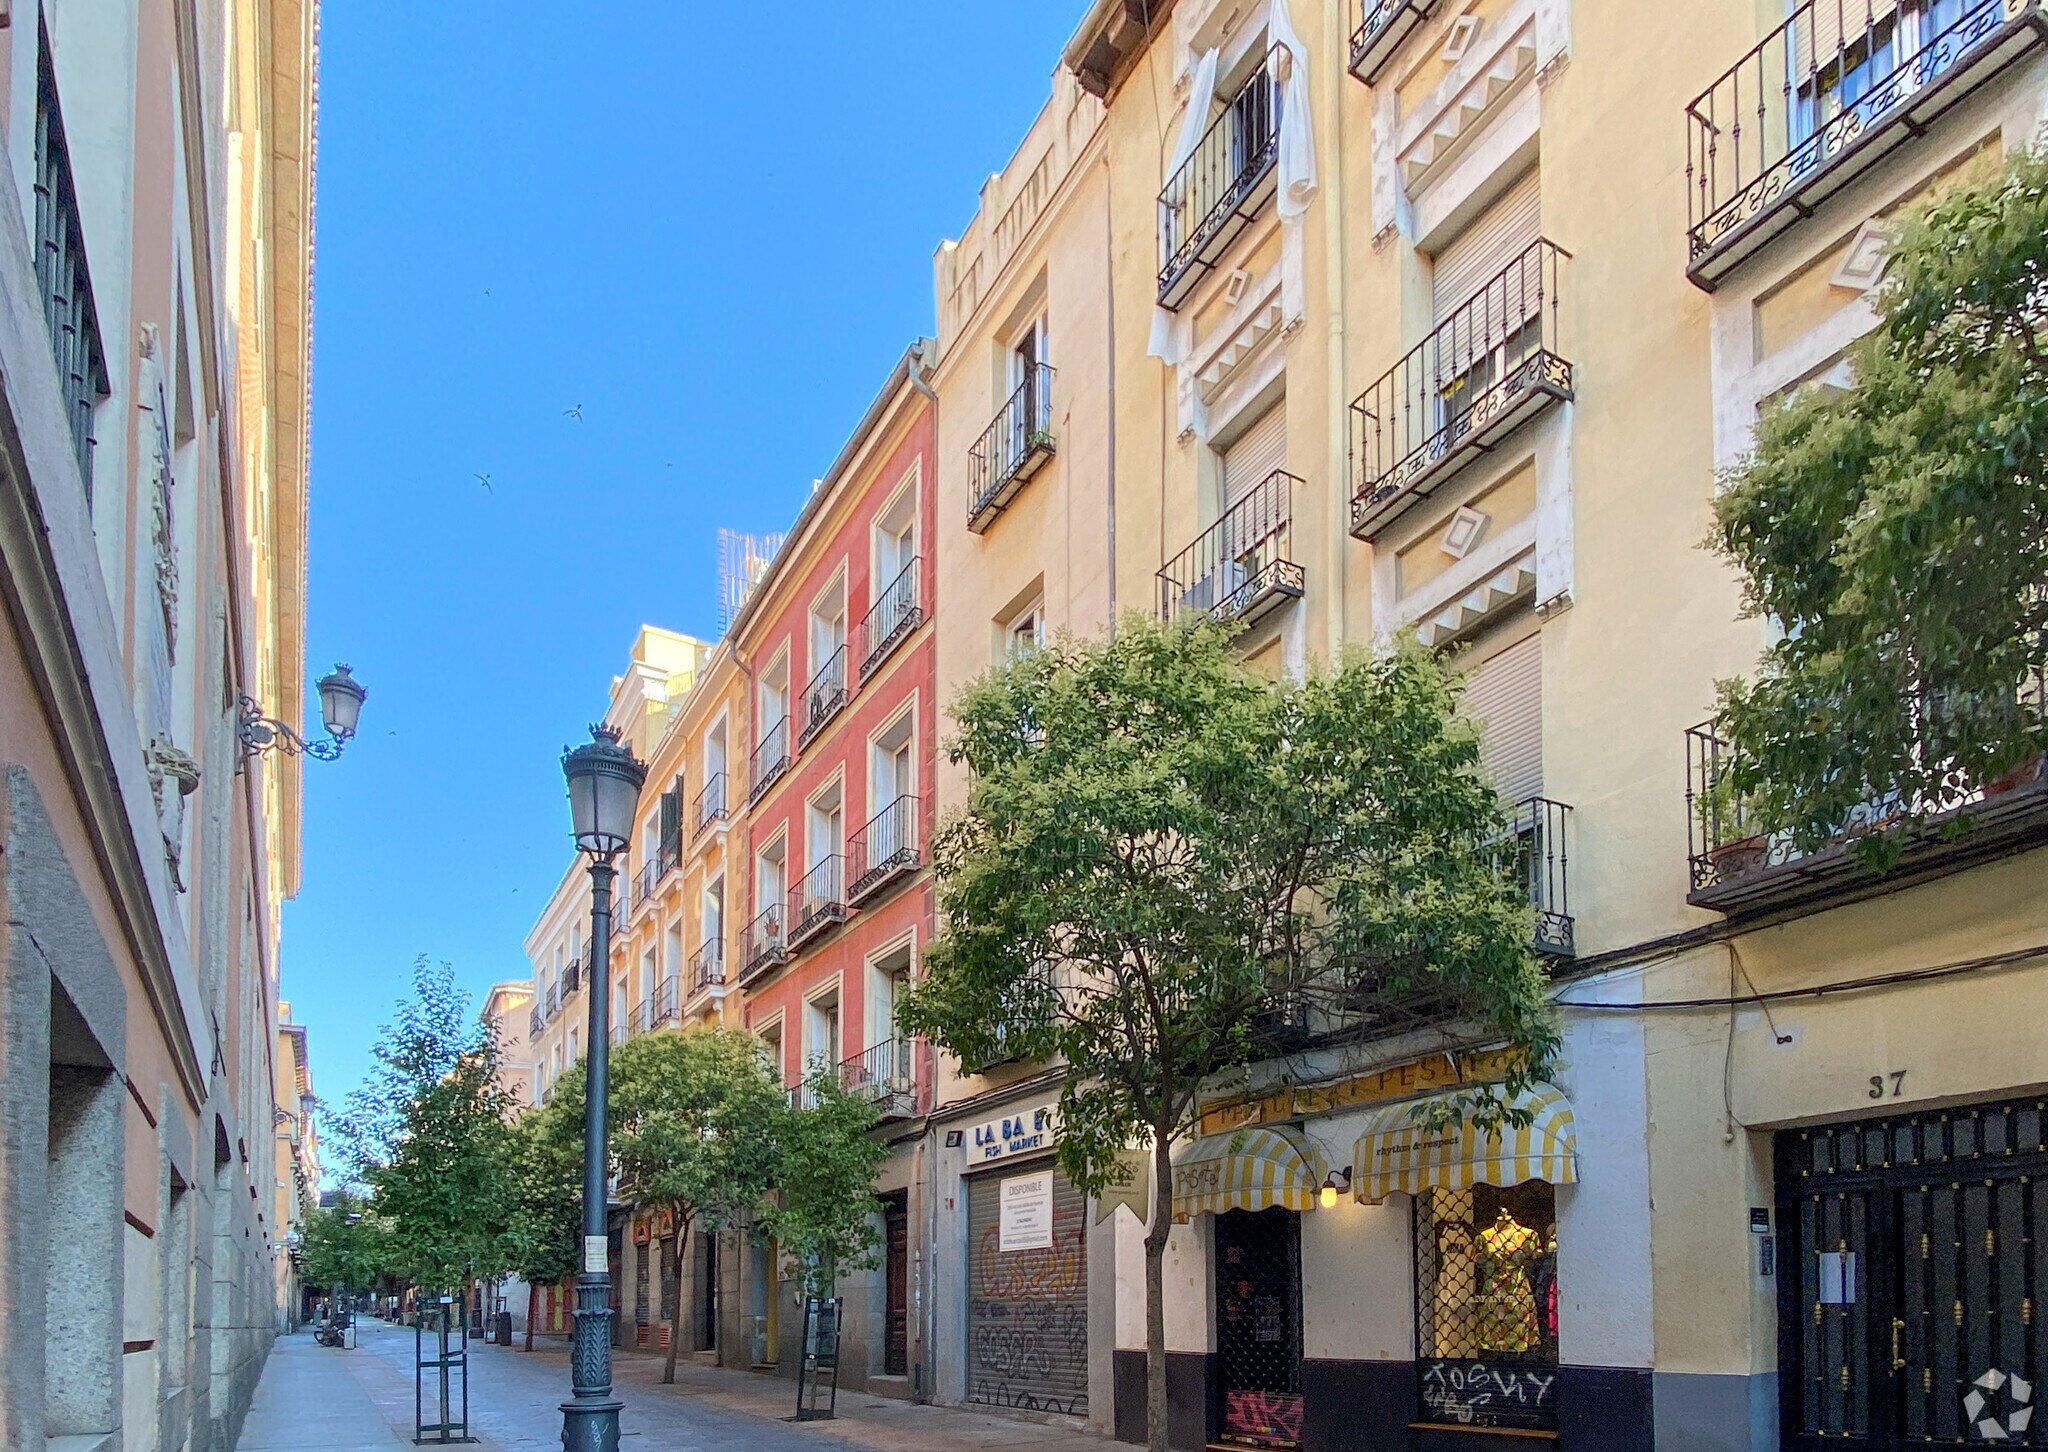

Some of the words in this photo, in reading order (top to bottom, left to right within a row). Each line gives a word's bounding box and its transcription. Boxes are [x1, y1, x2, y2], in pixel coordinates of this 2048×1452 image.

[1869, 1069, 1907, 1099] 37
[975, 1124, 995, 1147] LA
[985, 1143, 1002, 1158] FISH
[1009, 1134, 1044, 1152] MARKET
[1376, 1144, 1411, 1156] rhythm
[1412, 1141, 1420, 1151] &
[1423, 1136, 1460, 1149] respect
[1009, 1180, 1042, 1196] DISPONIBLE
